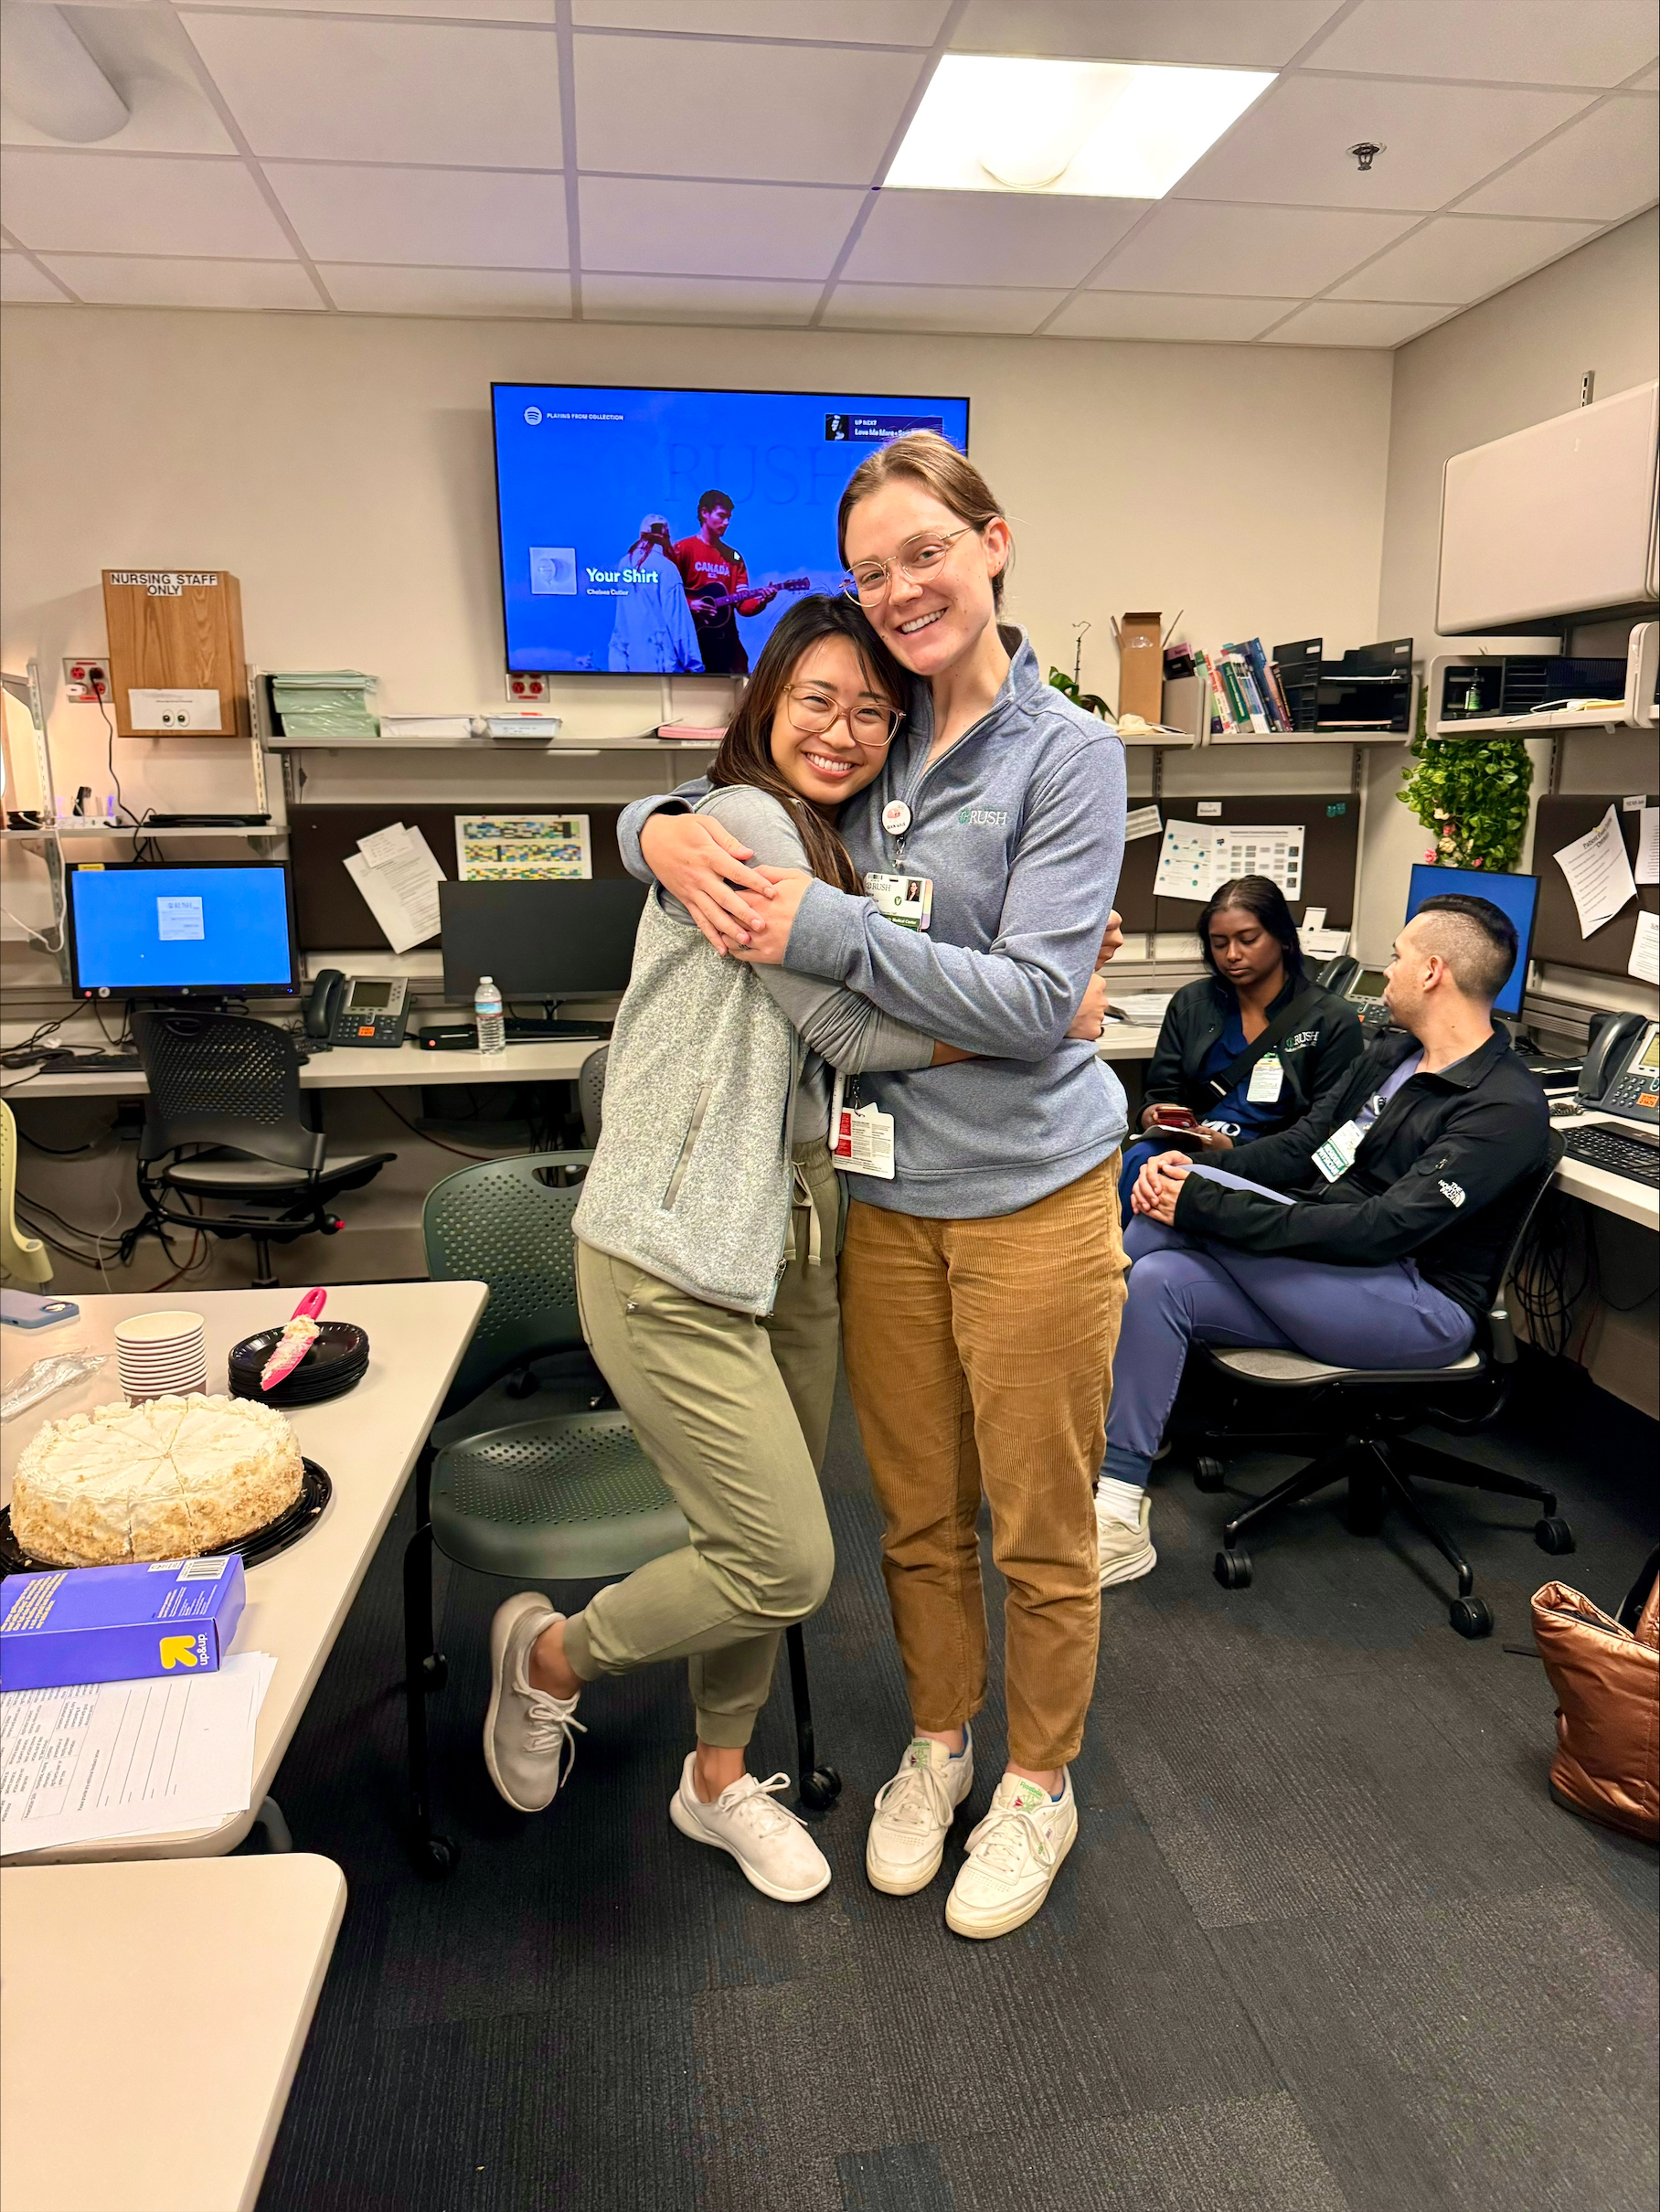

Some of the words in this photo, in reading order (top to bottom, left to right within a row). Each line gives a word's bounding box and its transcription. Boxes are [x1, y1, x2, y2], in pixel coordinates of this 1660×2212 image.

[547, 412, 570, 420] PLAYING
[586, 568, 620, 582] Your
[622, 569, 658, 583] Shirt
[695, 561, 730, 577] CANADA
[112, 573, 171, 585] NURSING
[176, 574, 217, 585] STAFF
[147, 584, 180, 595] ONLY
[586, 588, 610, 596] Chelsea
[969, 810, 1007, 825] RUSH
[871, 882, 891, 892] RUSH
[1293, 1031, 1320, 1046] RUSH
[197, 1633, 209, 1665] up&up
[1020, 1781, 1043, 1797] Reebok
